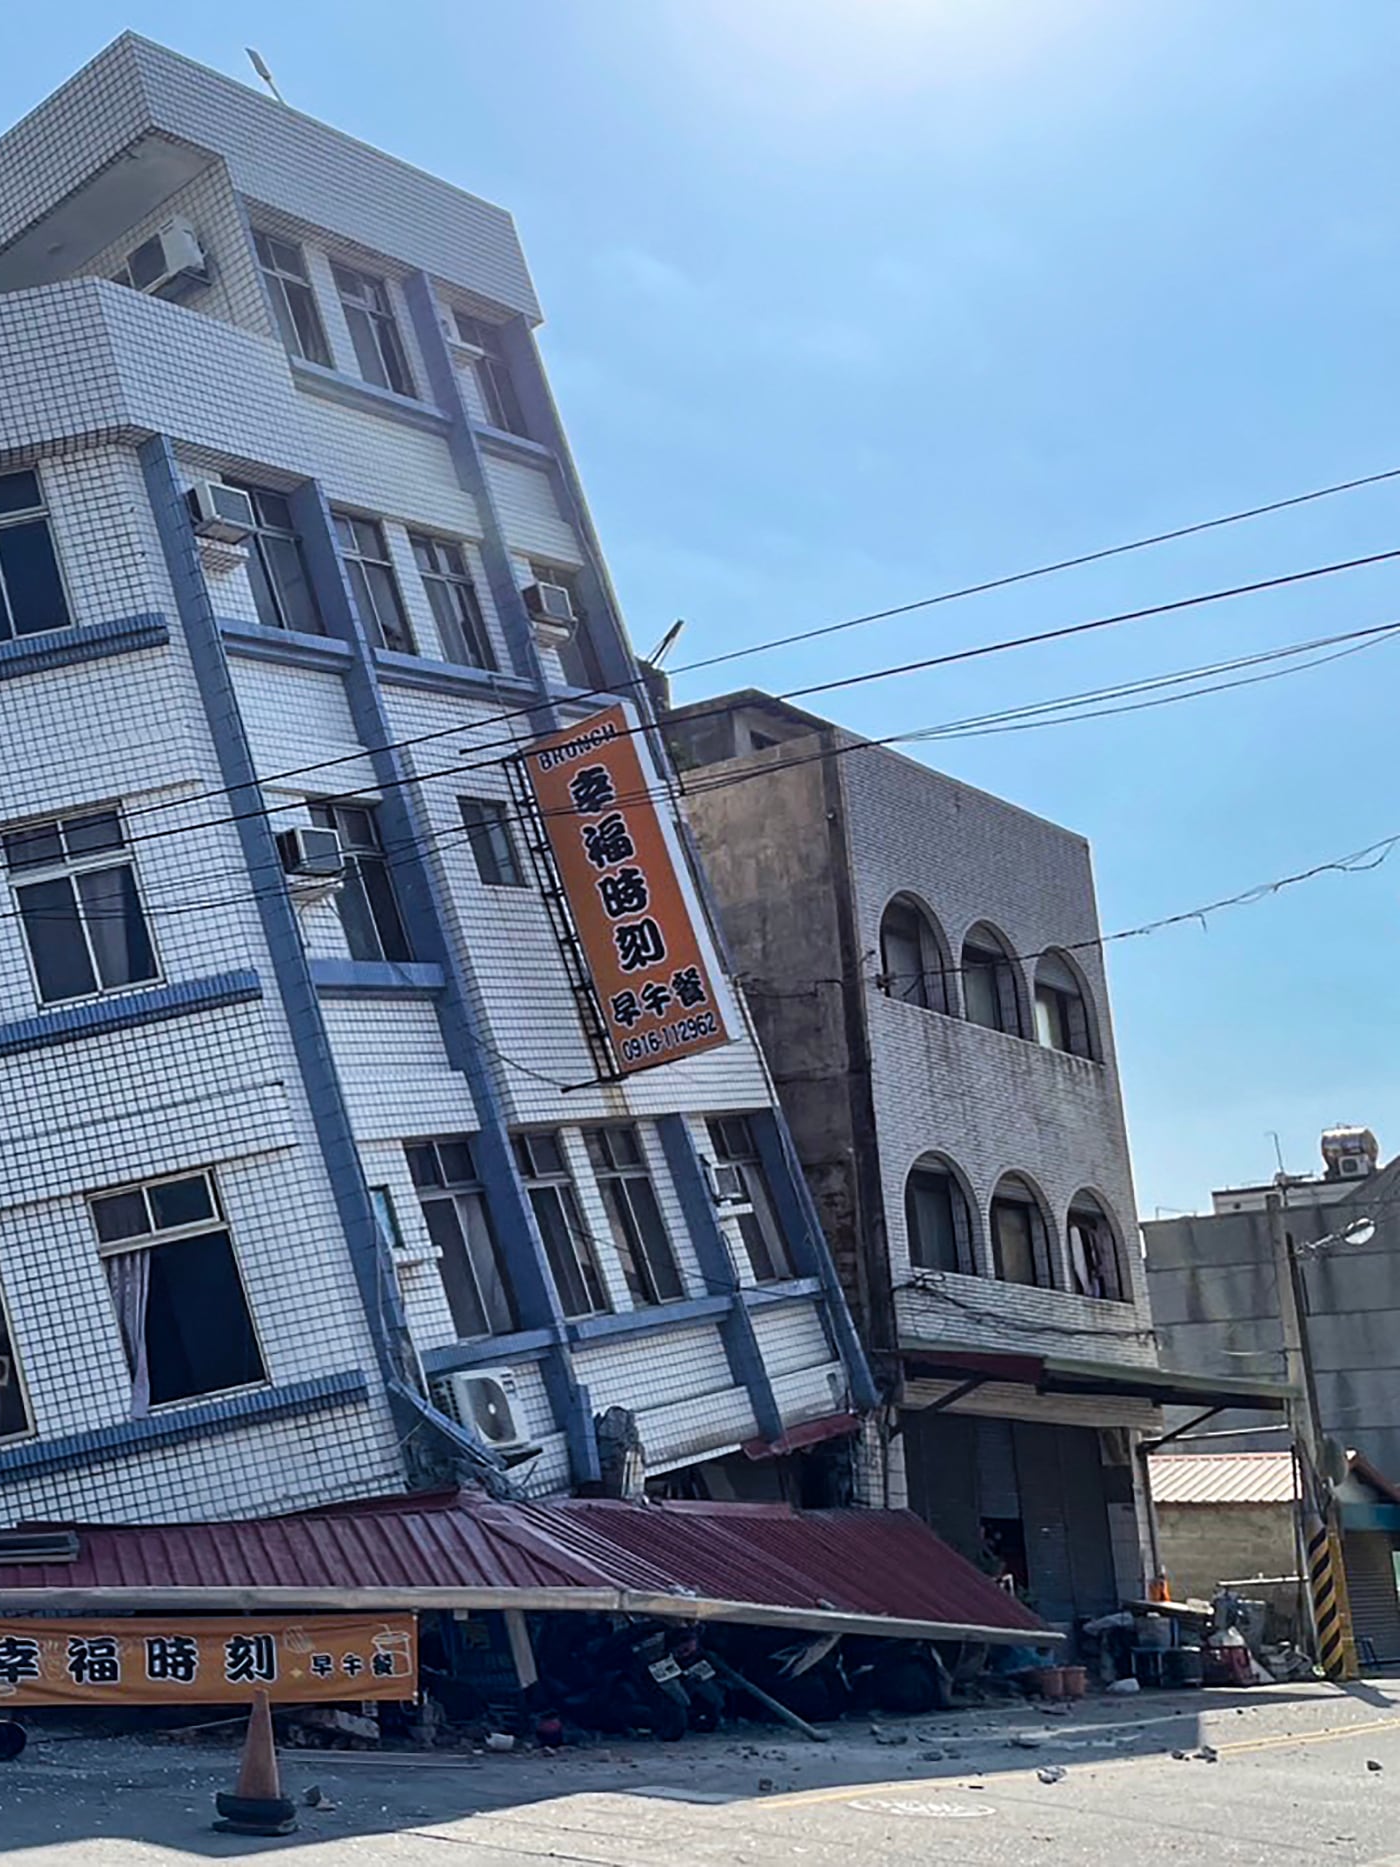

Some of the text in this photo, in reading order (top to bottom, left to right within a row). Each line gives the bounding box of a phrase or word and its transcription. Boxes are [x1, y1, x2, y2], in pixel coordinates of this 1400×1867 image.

[538, 721, 618, 771] BRUNCH
[569, 764, 667, 972] 幸福時刻
[610, 965, 707, 1028] 早午餐
[621, 1010, 718, 1062] 0916-112962
[310, 1651, 394, 1678] 早午餐
